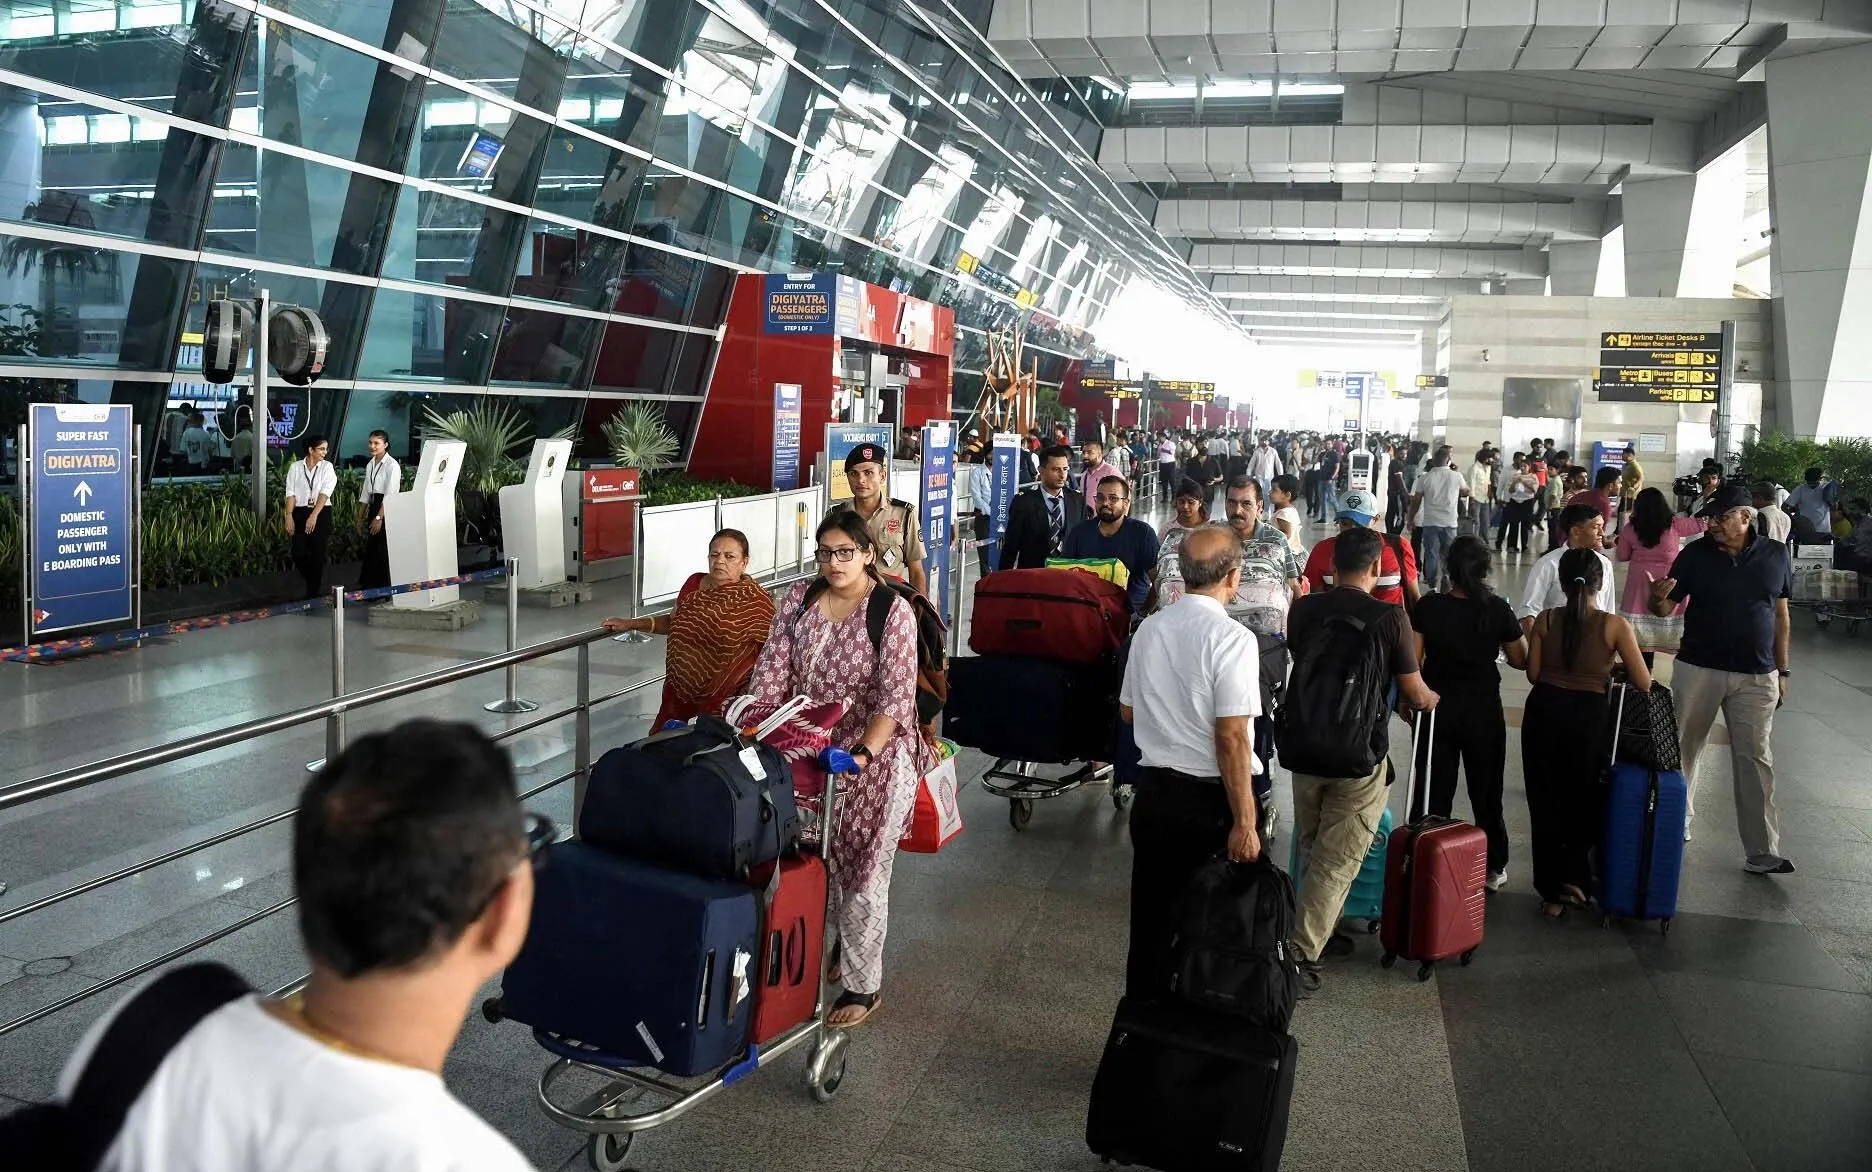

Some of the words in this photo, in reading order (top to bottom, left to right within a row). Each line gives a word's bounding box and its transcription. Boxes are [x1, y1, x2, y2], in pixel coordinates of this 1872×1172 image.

[772, 295, 826, 305] DIGIYATRA
[770, 305, 828, 314] PASSENGERS
[1649, 388, 1673, 396] Parking
[56, 431, 87, 442] SUPER
[87, 431, 109, 441] FAST
[47, 454, 116, 469] DIGIYATRA
[60, 510, 105, 524] DOMESTIC
[57, 525, 108, 539] PASSENGER
[58, 541, 83, 554] ONLY
[83, 540, 107, 552] WITH
[43, 562, 50, 572] E
[51, 557, 98, 571] BOARDING
[99, 554, 121, 566] PASS
